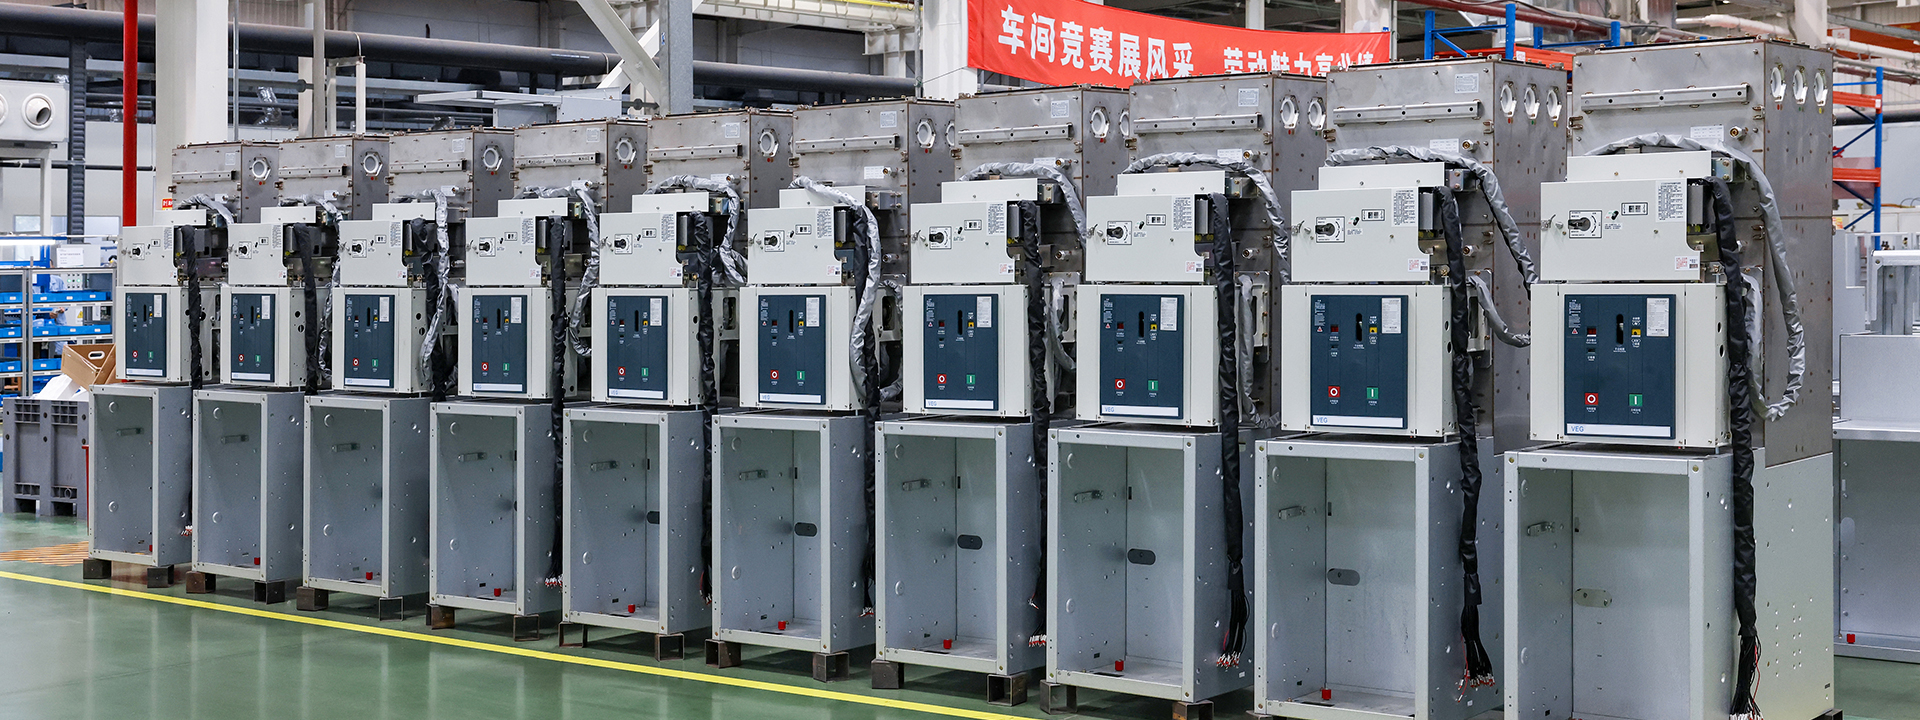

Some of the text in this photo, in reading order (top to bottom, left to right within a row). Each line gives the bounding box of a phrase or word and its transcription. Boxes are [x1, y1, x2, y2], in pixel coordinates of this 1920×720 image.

[998, 4, 1194, 80] 车间竞赛展风采
[1571, 425, 1584, 433] VEG
